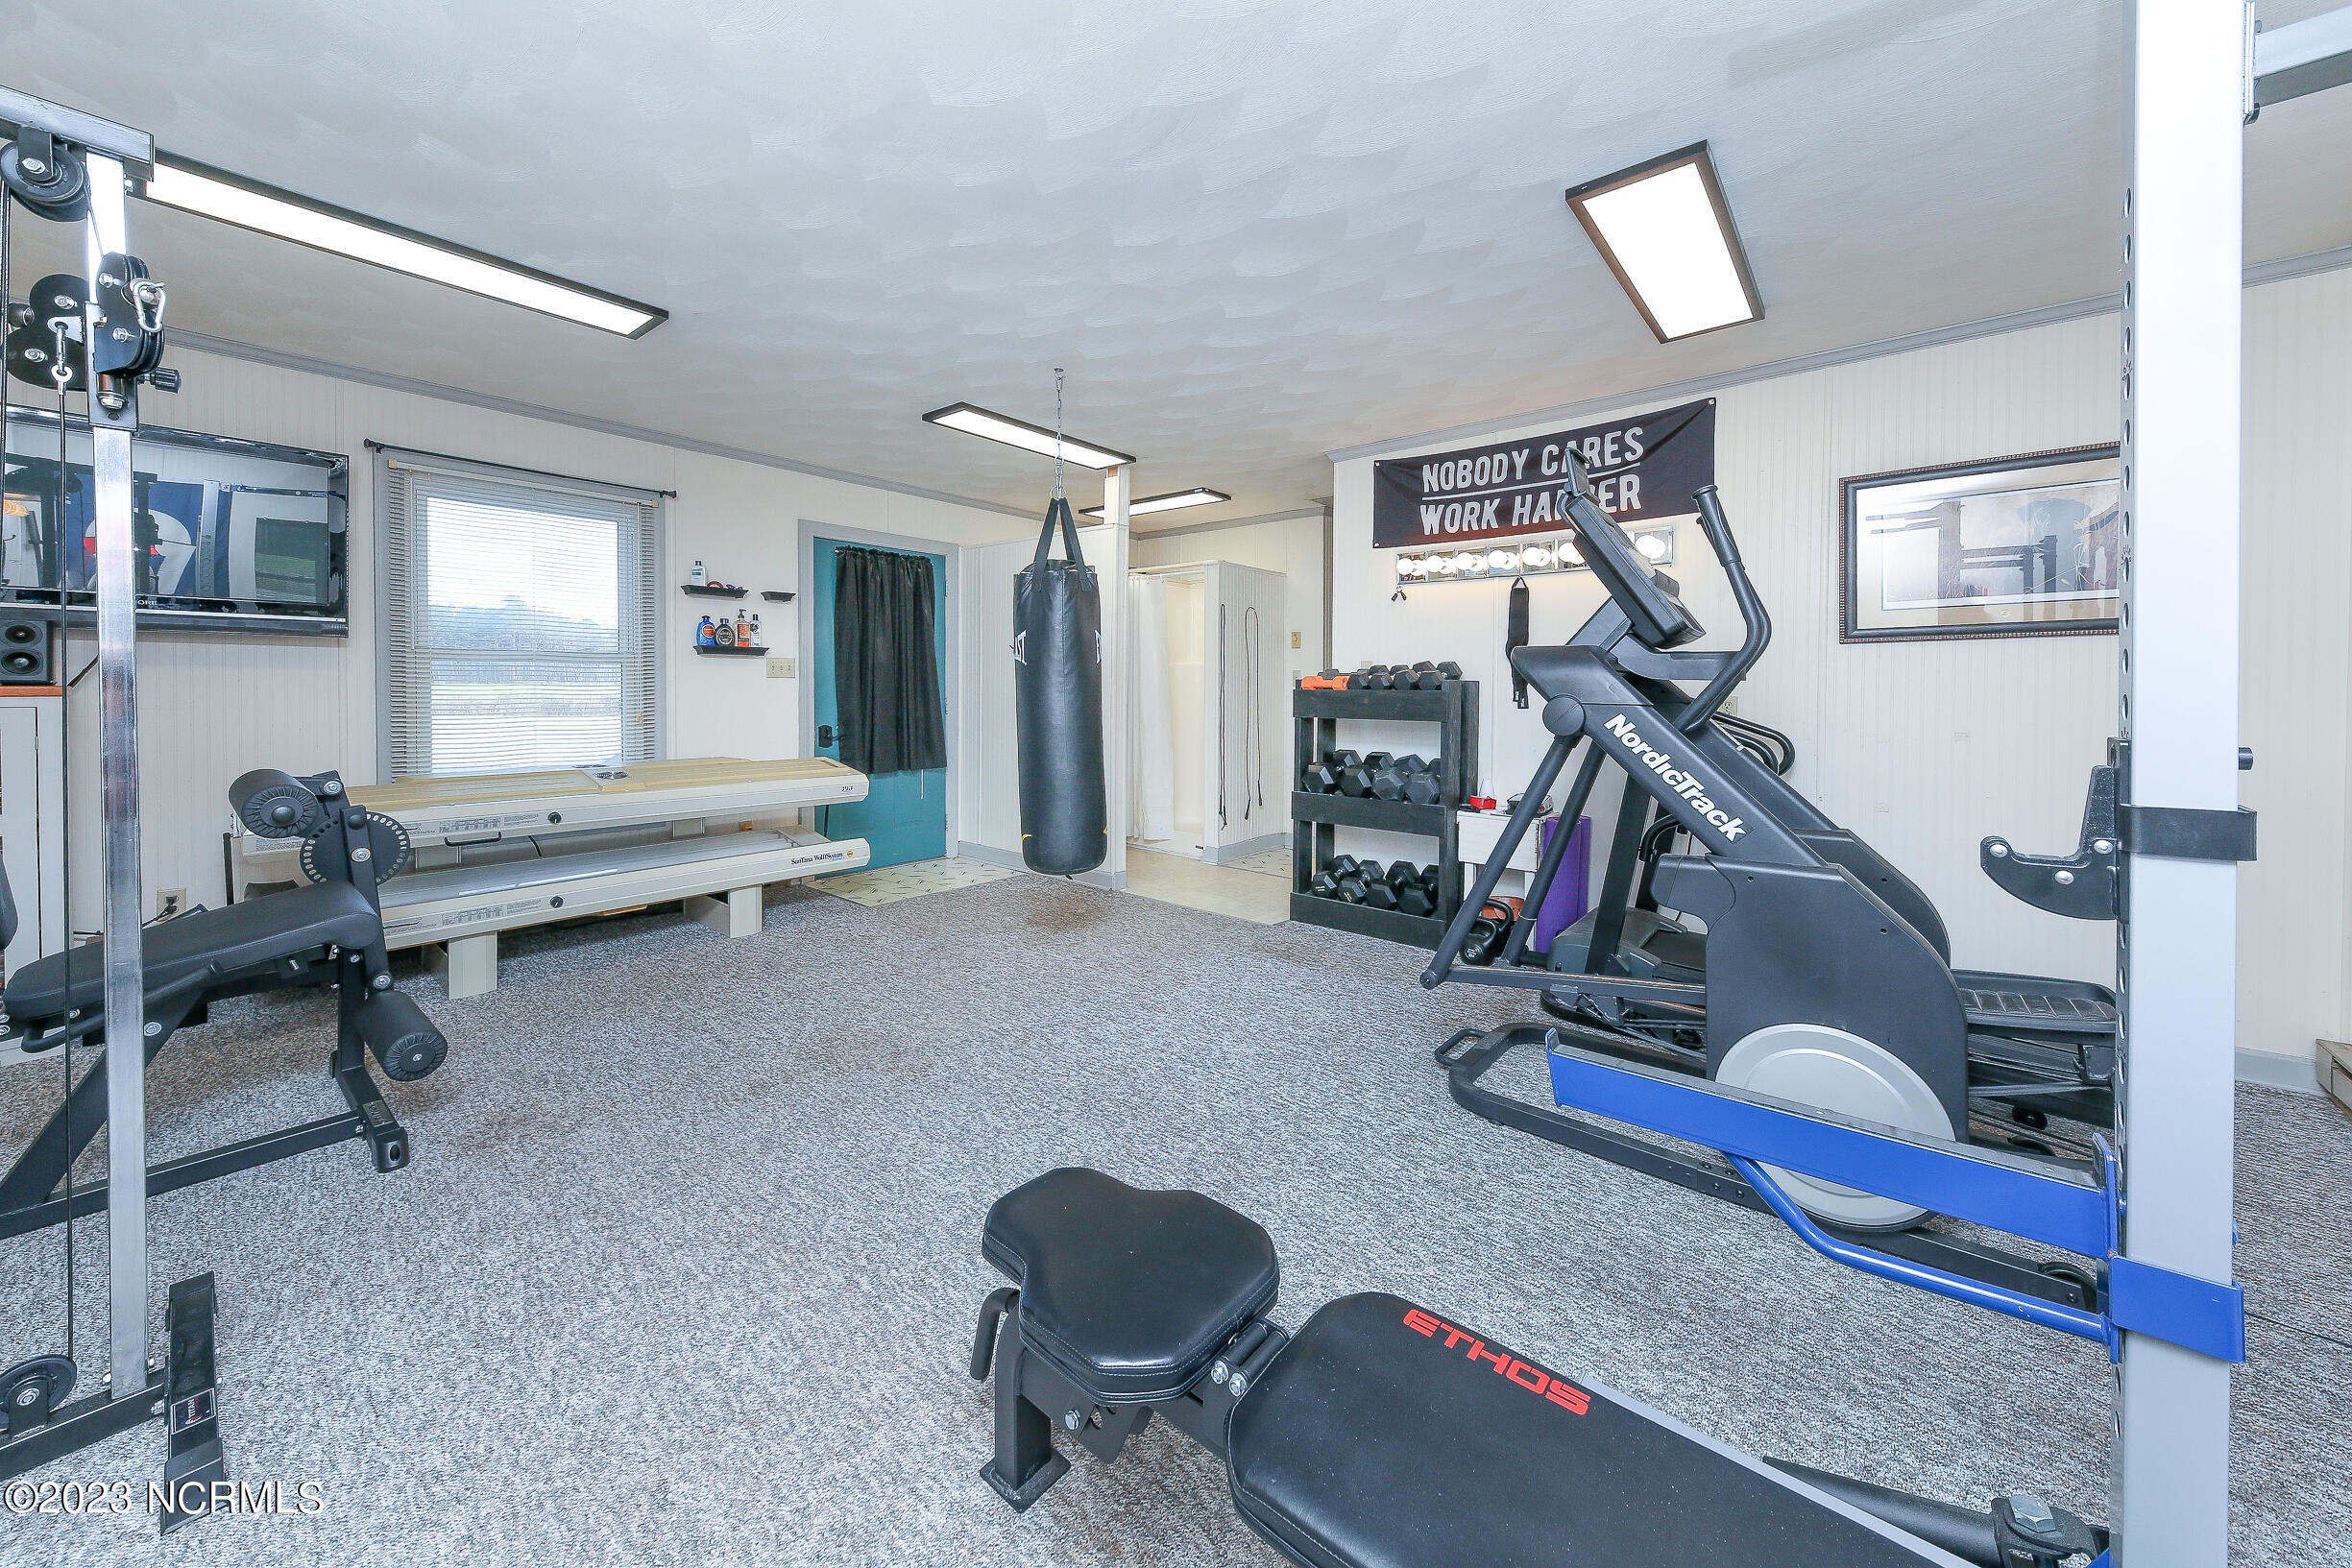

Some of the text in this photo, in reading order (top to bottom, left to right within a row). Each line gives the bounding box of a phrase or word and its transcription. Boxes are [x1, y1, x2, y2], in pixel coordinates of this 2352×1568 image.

[1420, 474, 1642, 535] WORK HAER
[1422, 448, 1530, 493] NOBODY
[1604, 713, 1747, 843] NordicTrack
[1402, 1309, 1591, 1416] ETHOS
